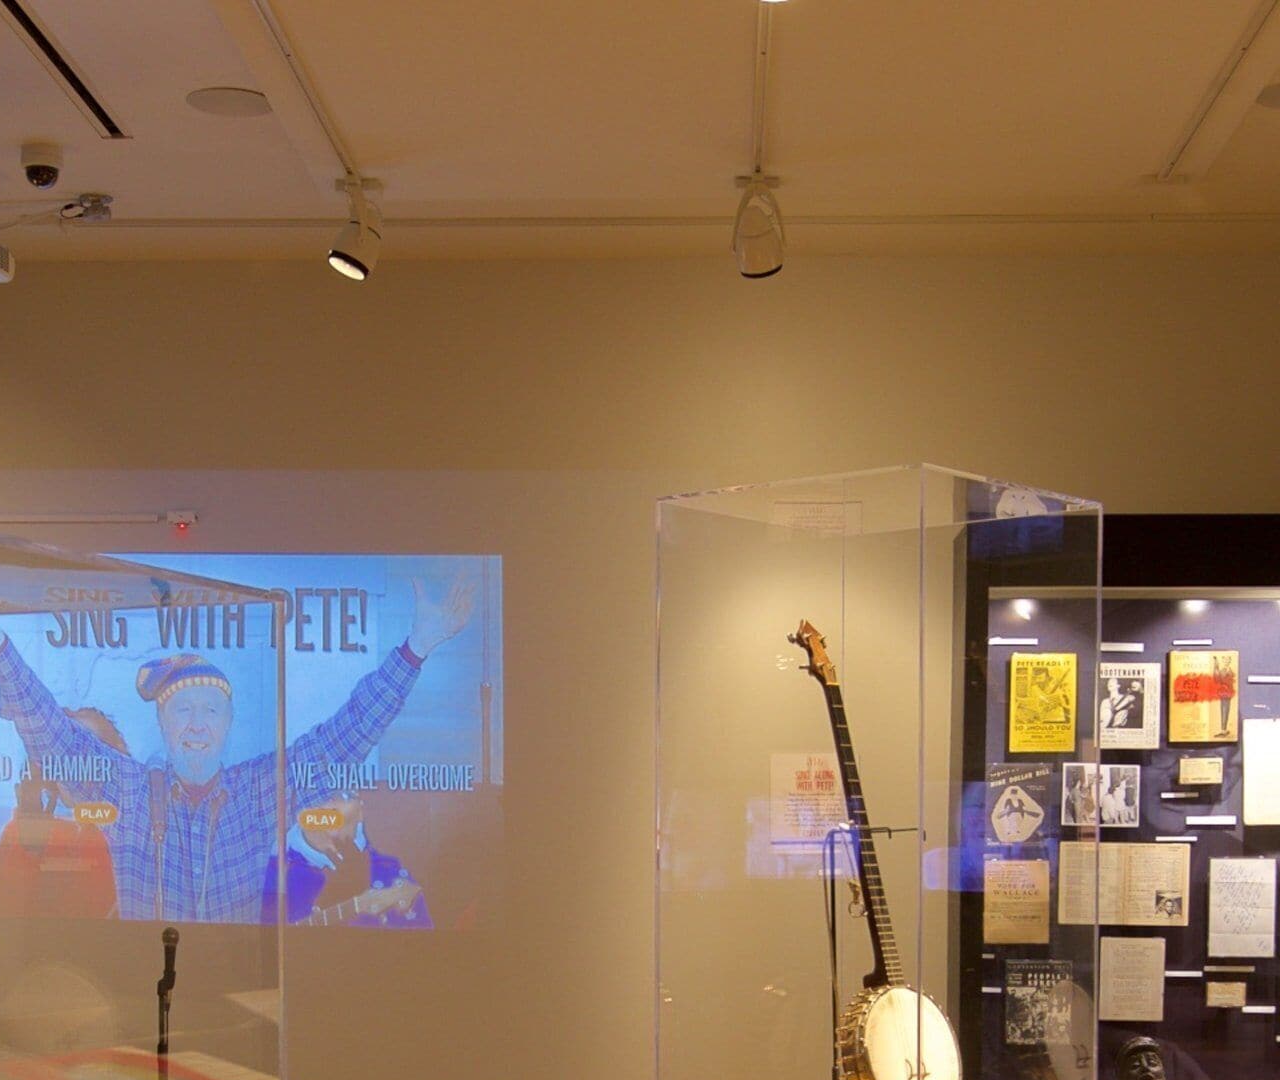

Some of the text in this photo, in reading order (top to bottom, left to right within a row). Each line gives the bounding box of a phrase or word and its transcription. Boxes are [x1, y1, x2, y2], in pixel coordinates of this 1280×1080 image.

[45, 587, 369, 654] SING WITH PETE!
[20, 754, 33, 781] A
[42, 754, 113, 783] HAMMER
[291, 762, 475, 792] WE SHALL OVERCOME
[81, 809, 111, 819] PLAY
[306, 815, 337, 826] PLAY
